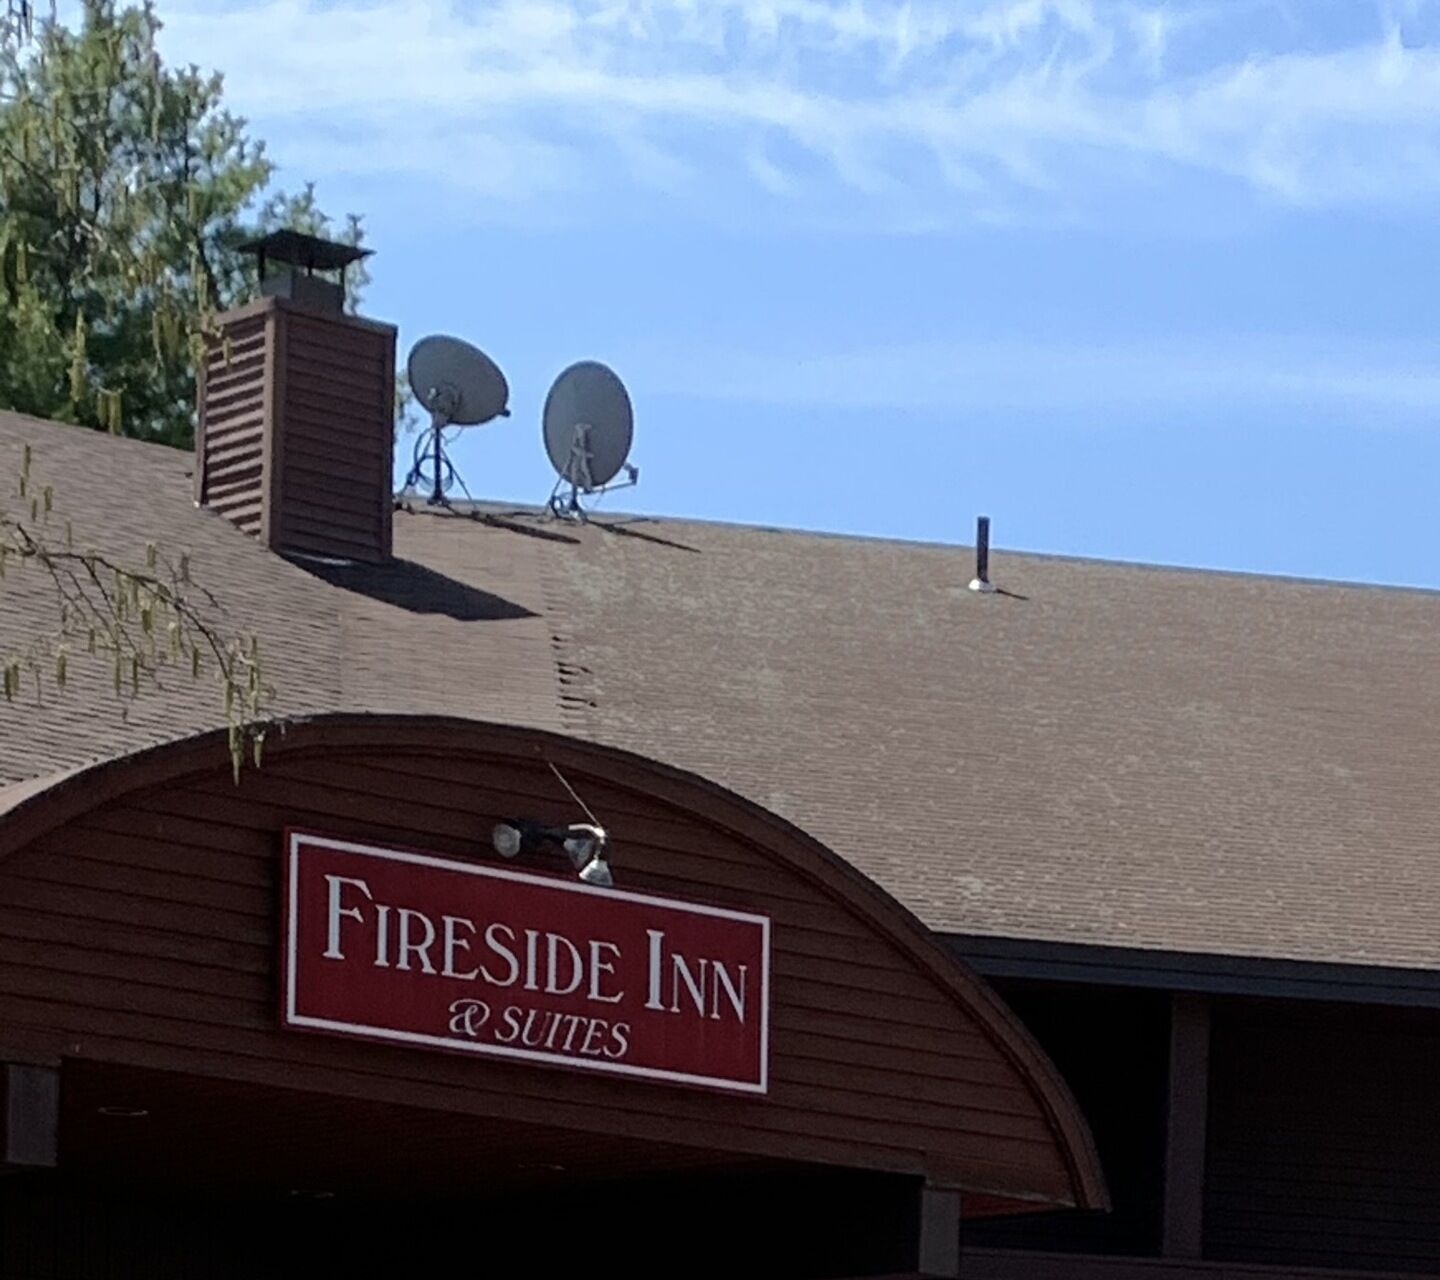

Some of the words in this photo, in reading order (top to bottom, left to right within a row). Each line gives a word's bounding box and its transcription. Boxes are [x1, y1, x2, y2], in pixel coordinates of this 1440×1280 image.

[321, 874, 625, 1004] FIRESIDE
[643, 929, 748, 1025] INN
[494, 1005, 631, 1058] SUITES
